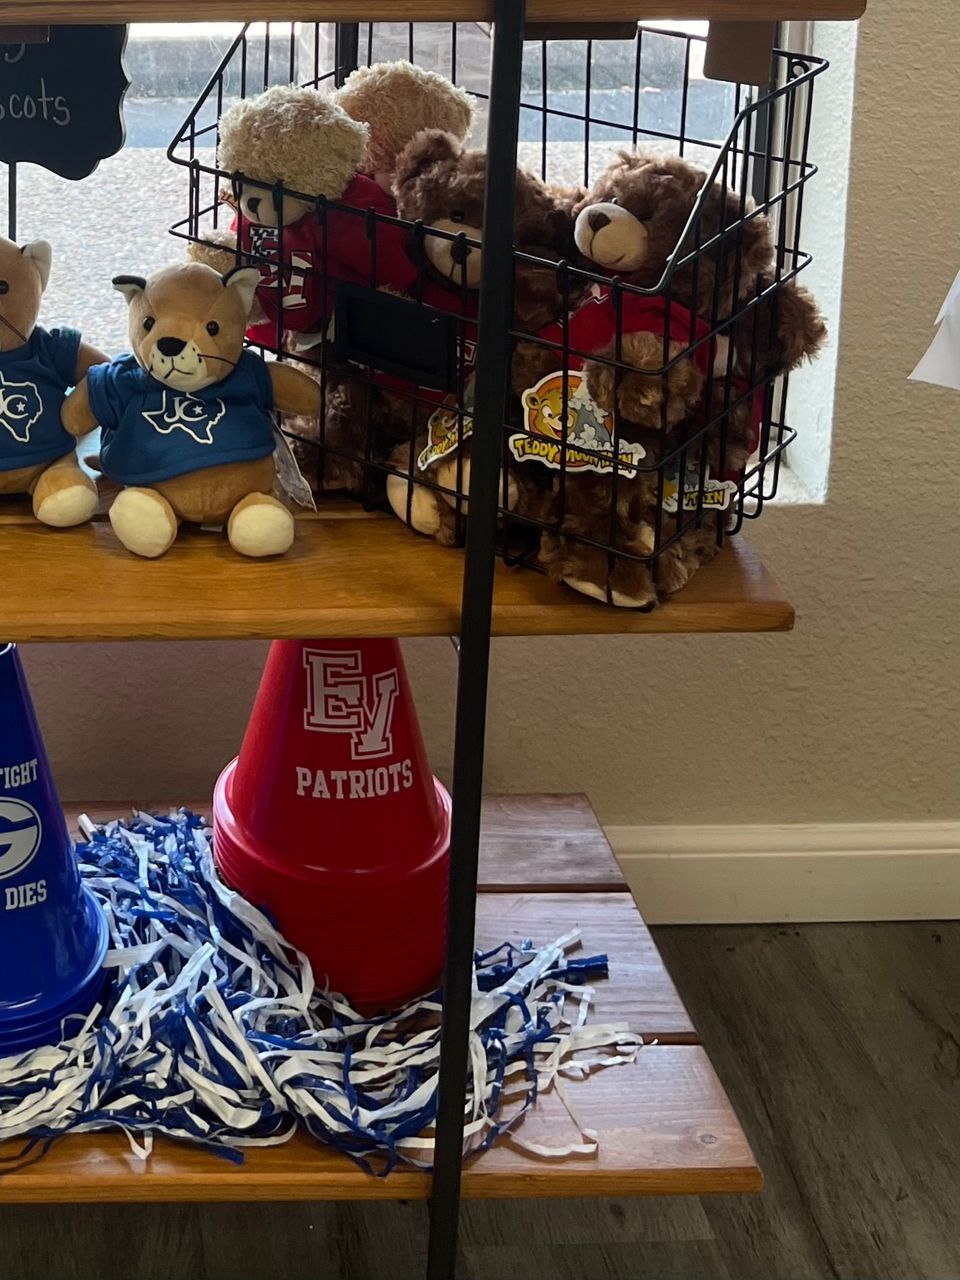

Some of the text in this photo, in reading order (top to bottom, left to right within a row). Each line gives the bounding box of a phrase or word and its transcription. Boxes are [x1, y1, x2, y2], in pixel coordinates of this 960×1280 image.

[163, 396, 209, 423] JC
[513, 437, 560, 464] TEDDY
[302, 647, 400, 761] EV
[295, 758, 414, 800] PATRIOTS
[5, 879, 48, 910] DIES
